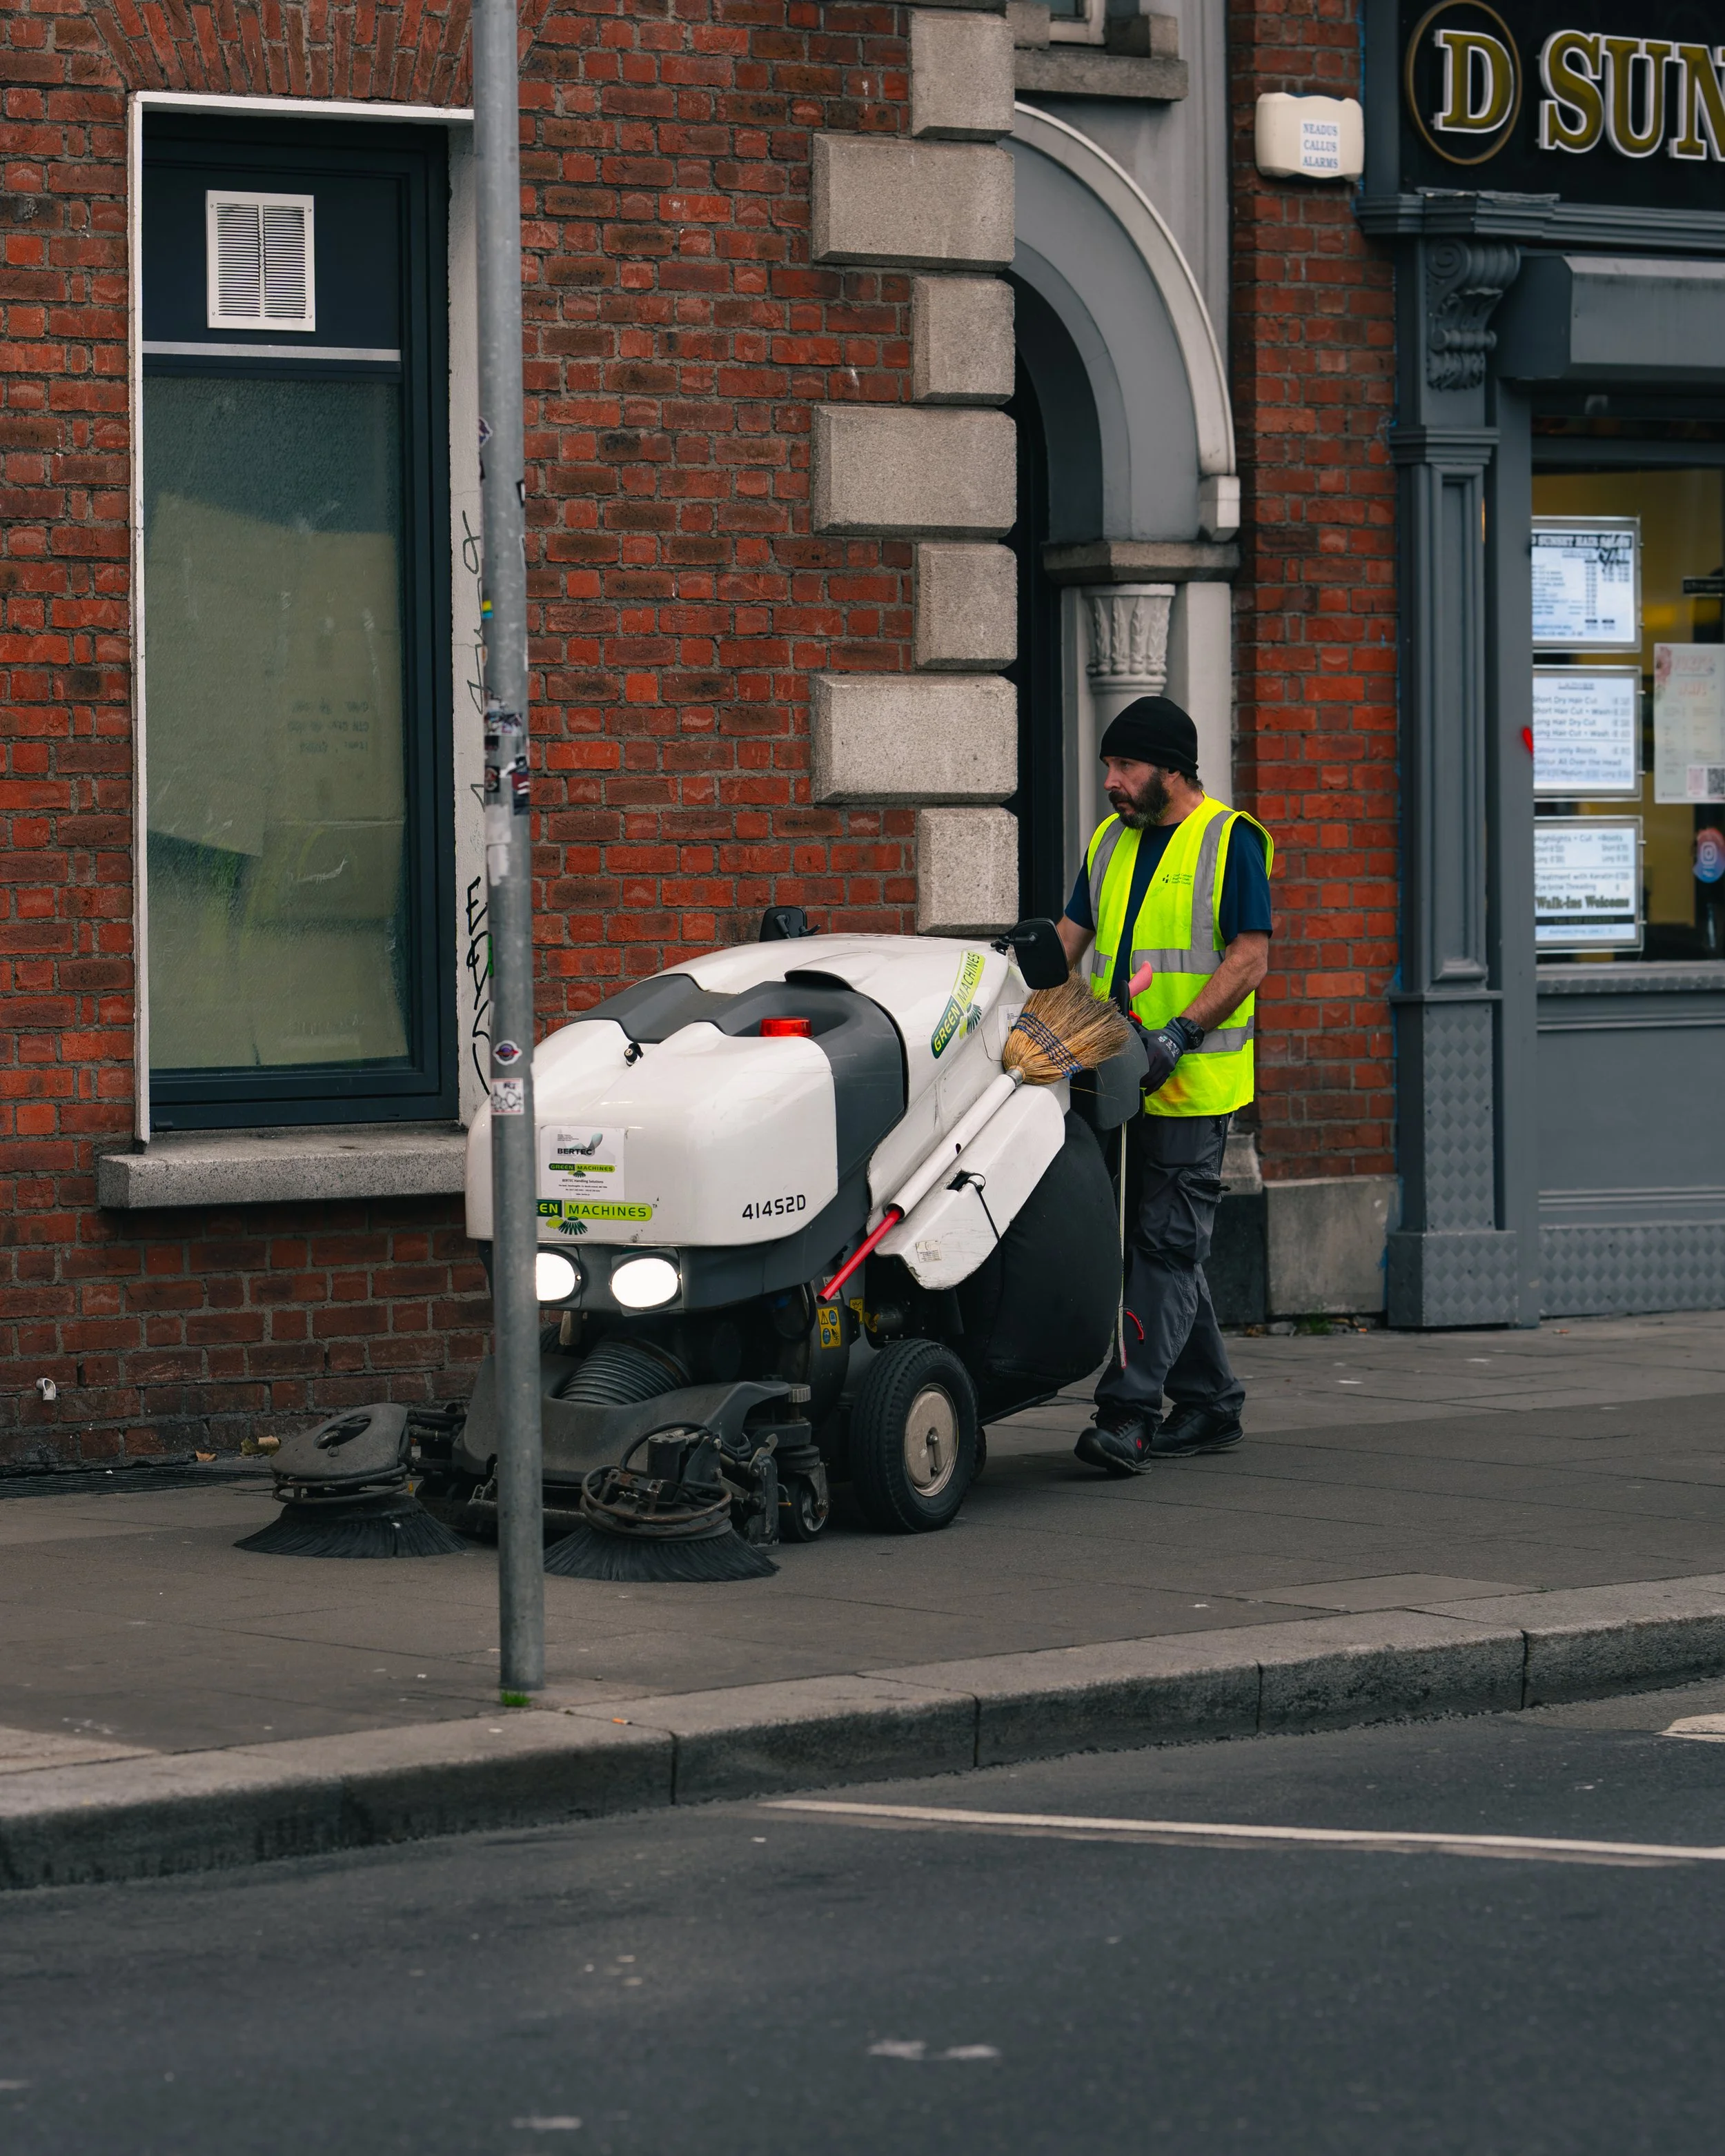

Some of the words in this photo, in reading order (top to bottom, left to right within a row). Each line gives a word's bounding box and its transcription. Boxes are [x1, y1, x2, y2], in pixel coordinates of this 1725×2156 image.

[1435, 29, 1515, 134] D
[1538, 30, 1725, 162] SUN
[1303, 156, 1339, 169] ALARMS
[934, 1002, 960, 1051] GREEN
[957, 952, 980, 1005] MACHINES
[535, 1203, 558, 1214] EN
[569, 1205, 647, 1217] MACHINES
